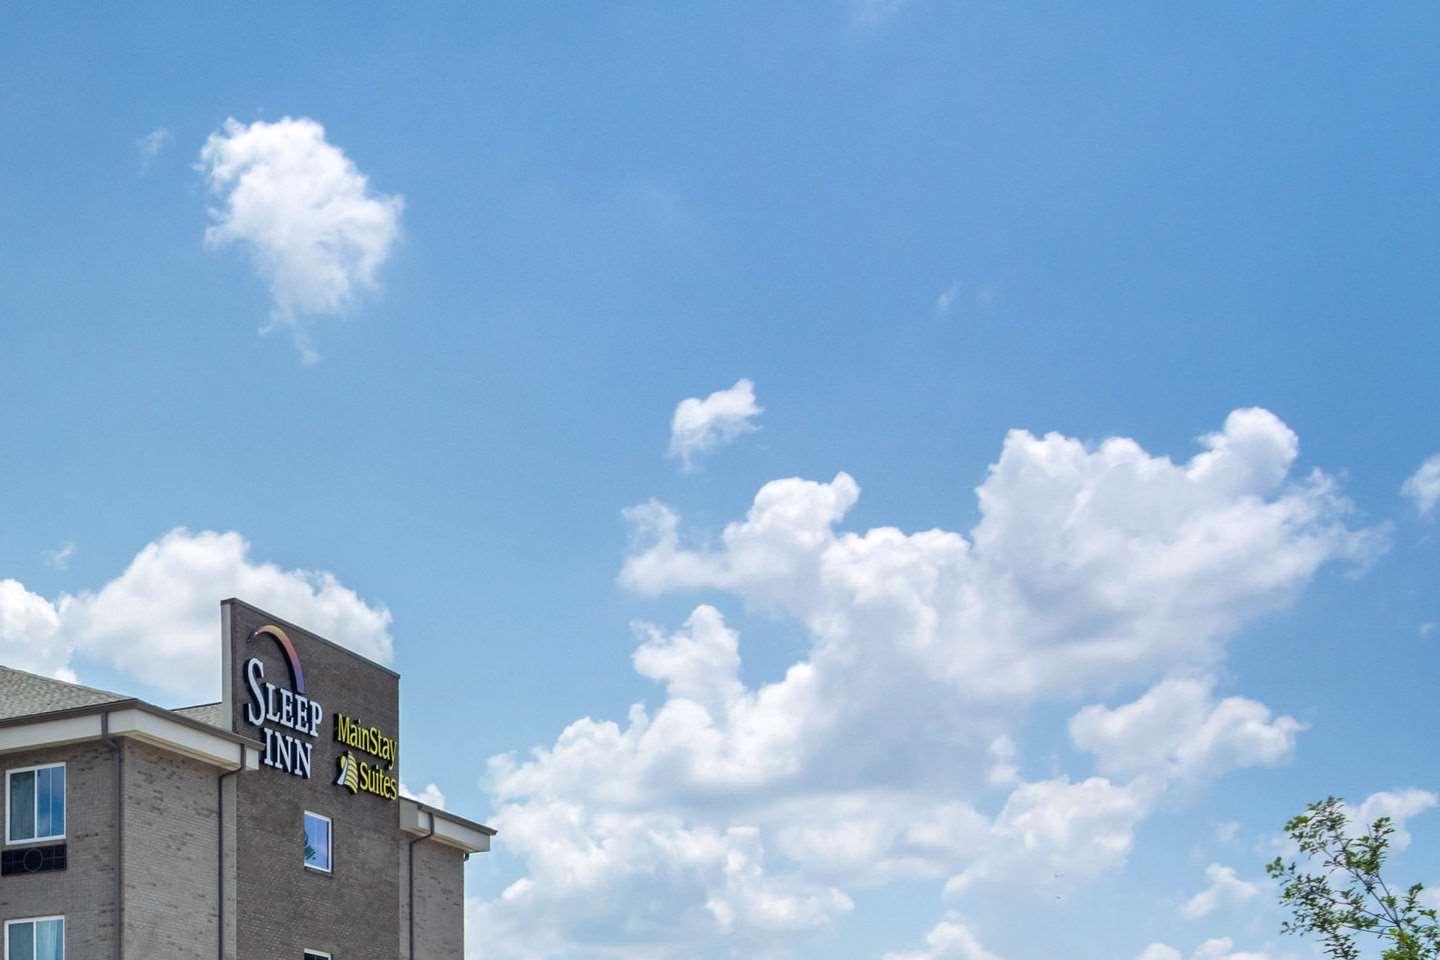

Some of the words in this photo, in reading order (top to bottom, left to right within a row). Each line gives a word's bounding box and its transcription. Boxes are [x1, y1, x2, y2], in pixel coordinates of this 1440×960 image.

[248, 658, 323, 737] SLEEP
[264, 728, 313, 779] INN
[338, 714, 398, 768] MainStay
[360, 762, 399, 801] Suites
